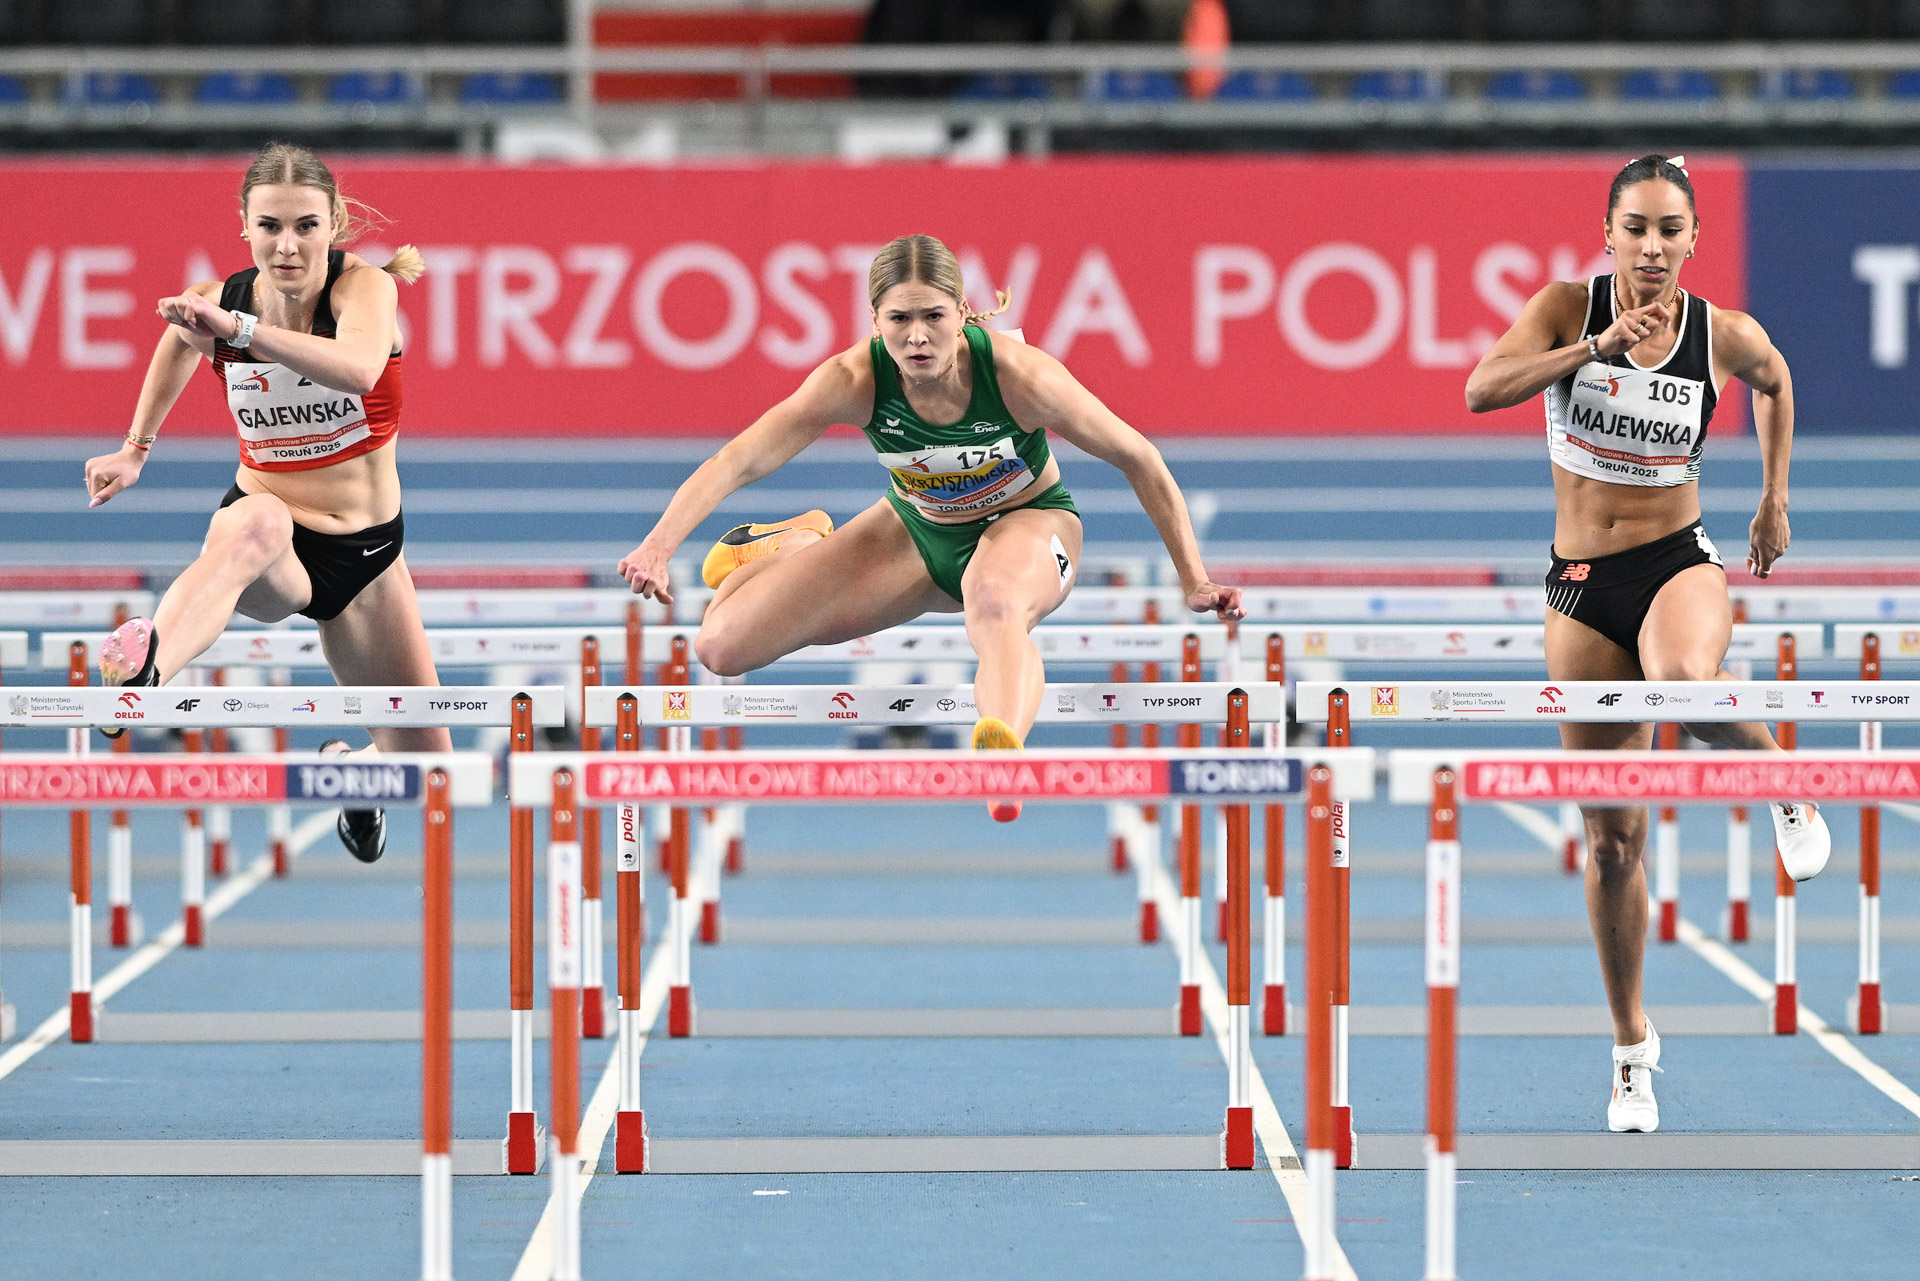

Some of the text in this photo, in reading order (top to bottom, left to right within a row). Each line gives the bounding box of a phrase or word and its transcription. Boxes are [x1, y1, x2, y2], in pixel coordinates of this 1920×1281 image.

[231, 382, 261, 392] polanik
[1577, 379, 1610, 394] polanik
[1648, 379, 1691, 406] 105
[237, 397, 359, 429] GAJEWSKA
[974, 425, 1000, 434] Enea
[1571, 403, 1692, 445] MAJEWSKA
[301, 430, 343, 444] Mistrzostwa
[880, 428, 905, 436] erima
[272, 441, 341, 458] TORUŃ 2025
[956, 446, 1004, 470] 175
[1624, 452, 1665, 464] Mistrzostwa
[1591, 457, 1659, 477] TORUŃ 2025
[979, 491, 1007, 509] 2025
[175, 699, 201, 712] 4F
[889, 699, 914, 712] 4F
[1143, 697, 1202, 707] TVP SPORT
[1478, 698, 1506, 706] Turystyki
[1597, 693, 1623, 706] 4F
[1669, 696, 1692, 704] Okęcie
[1851, 695, 1910, 705] TVP SPORT
[30, 704, 51, 712] Sportu
[56, 704, 84, 712] Turystyki
[247, 702, 270, 710] Okęcie
[429, 701, 488, 711] TVP SPORT
[770, 704, 798, 712] Turystyki
[1371, 704, 1400, 715] PZLA
[114, 711, 145, 719] ORLEN
[663, 709, 690, 719] PZLA
[828, 711, 859, 719] ORLEN
[162, 766, 268, 798] POLSKI
[599, 762, 1152, 797] PZLA HALOWE MISTRZOSTWA POLSKI
[1476, 762, 1919, 798] PZLA HALOWE MISTRZOSTWA
